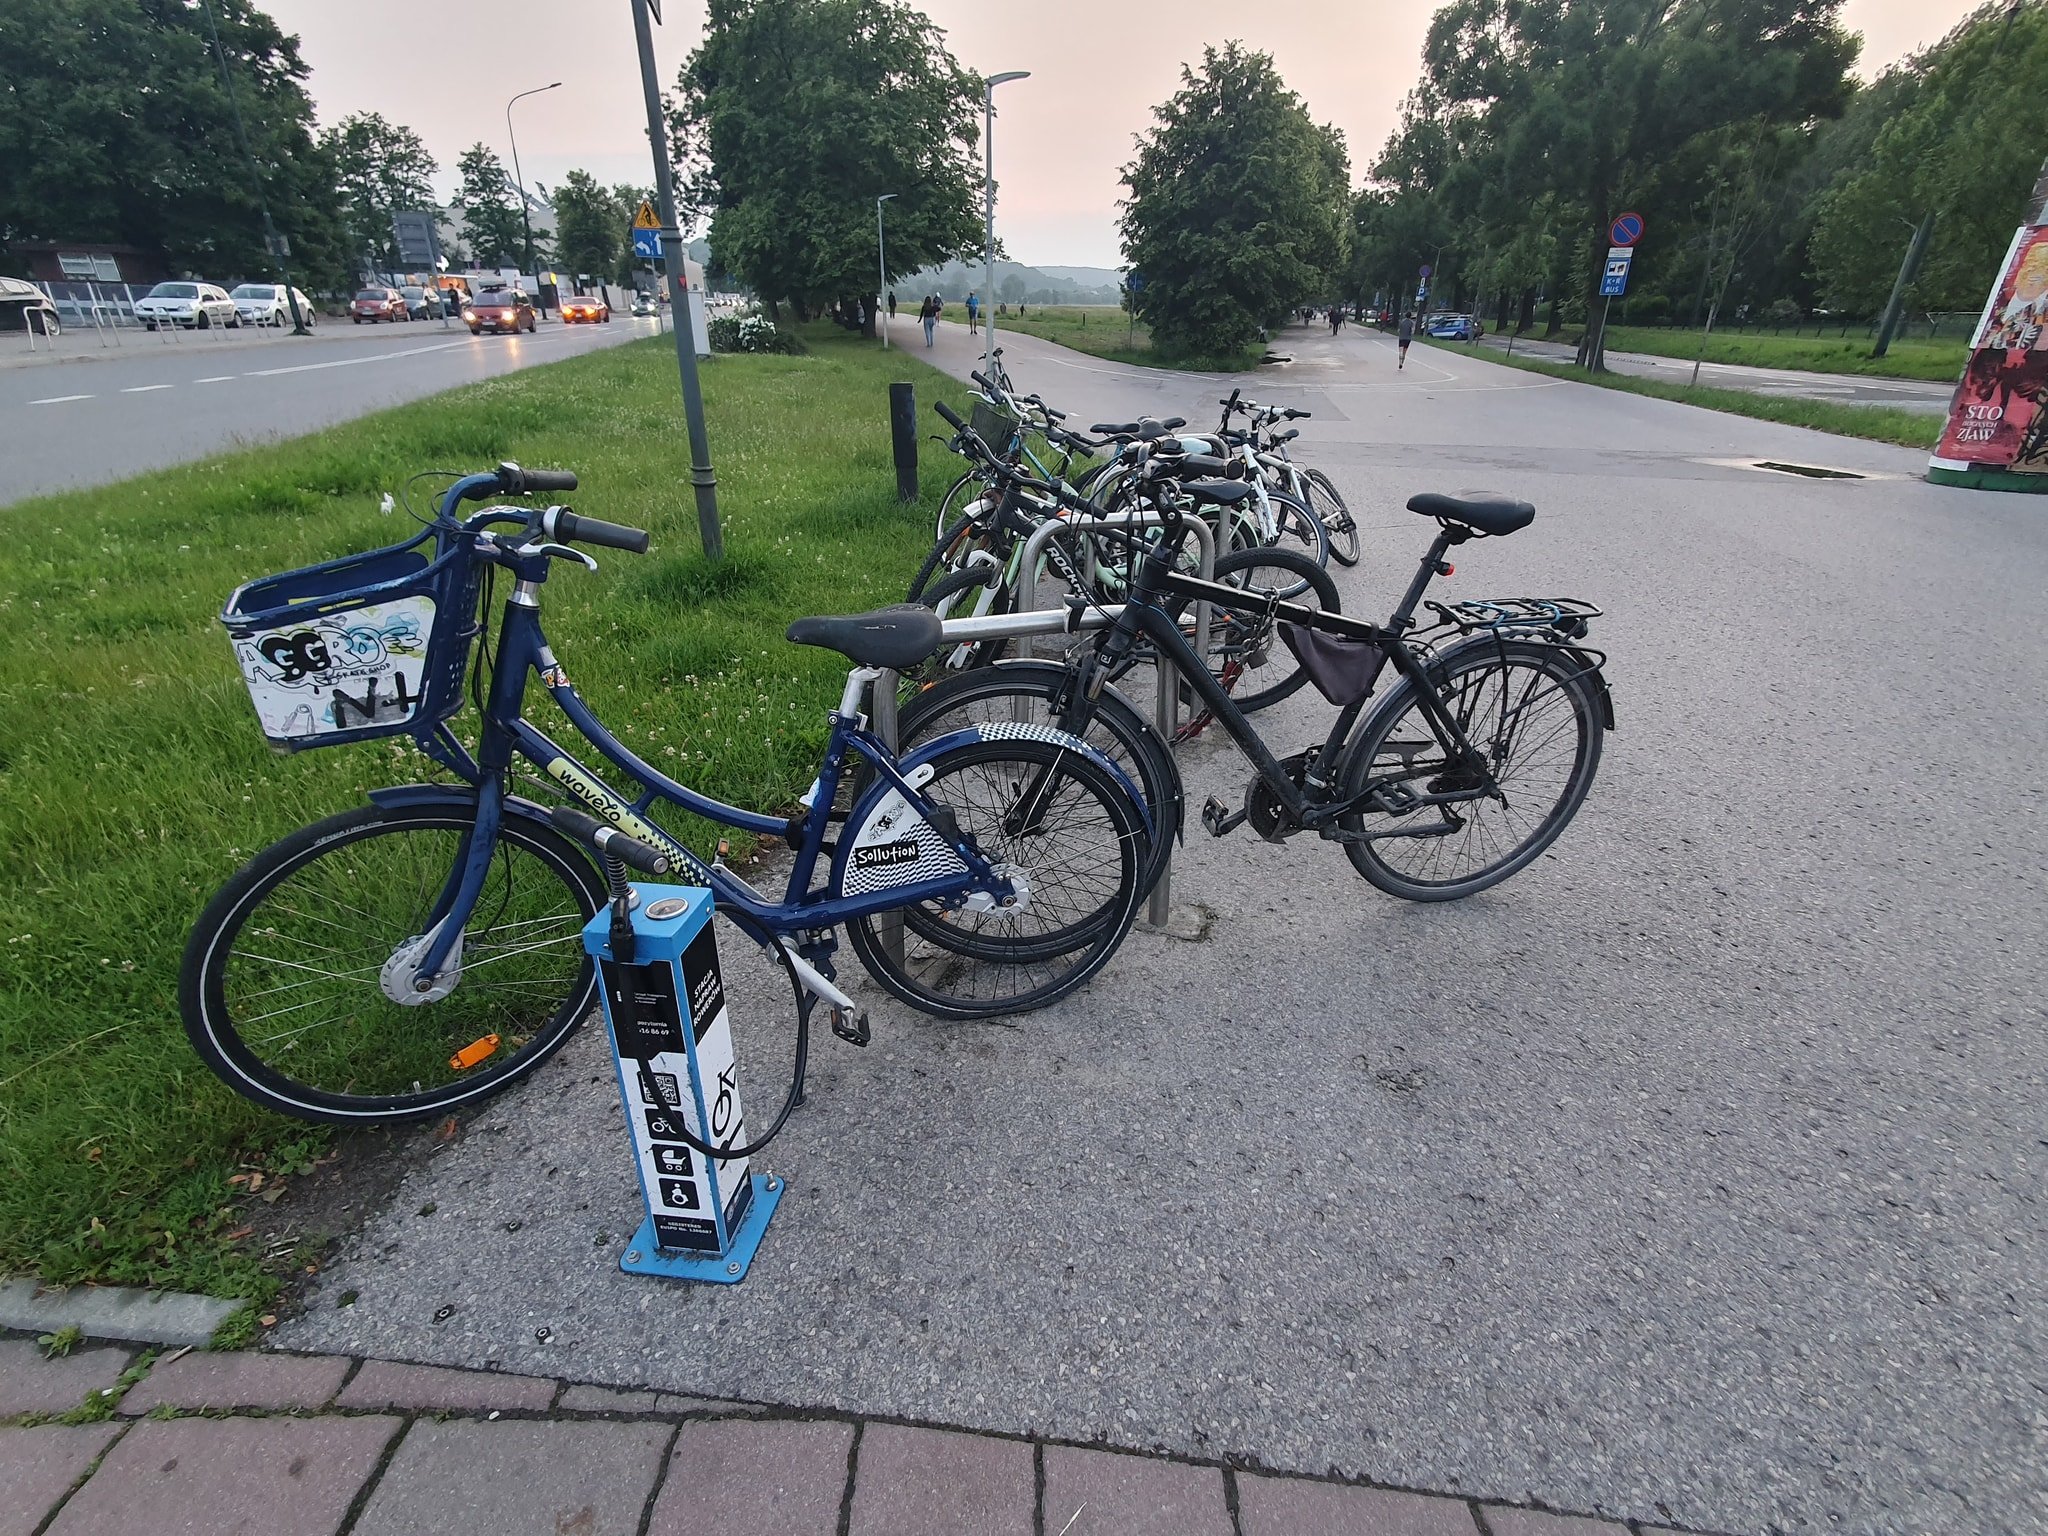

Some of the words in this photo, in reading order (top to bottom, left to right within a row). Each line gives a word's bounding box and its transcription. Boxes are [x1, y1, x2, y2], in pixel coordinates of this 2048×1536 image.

[1965, 405, 2003, 420] STO
[559, 769, 621, 822] wavelo
[694, 969, 714, 998] STACJA
[694, 975, 717, 1012] NAPRAW
